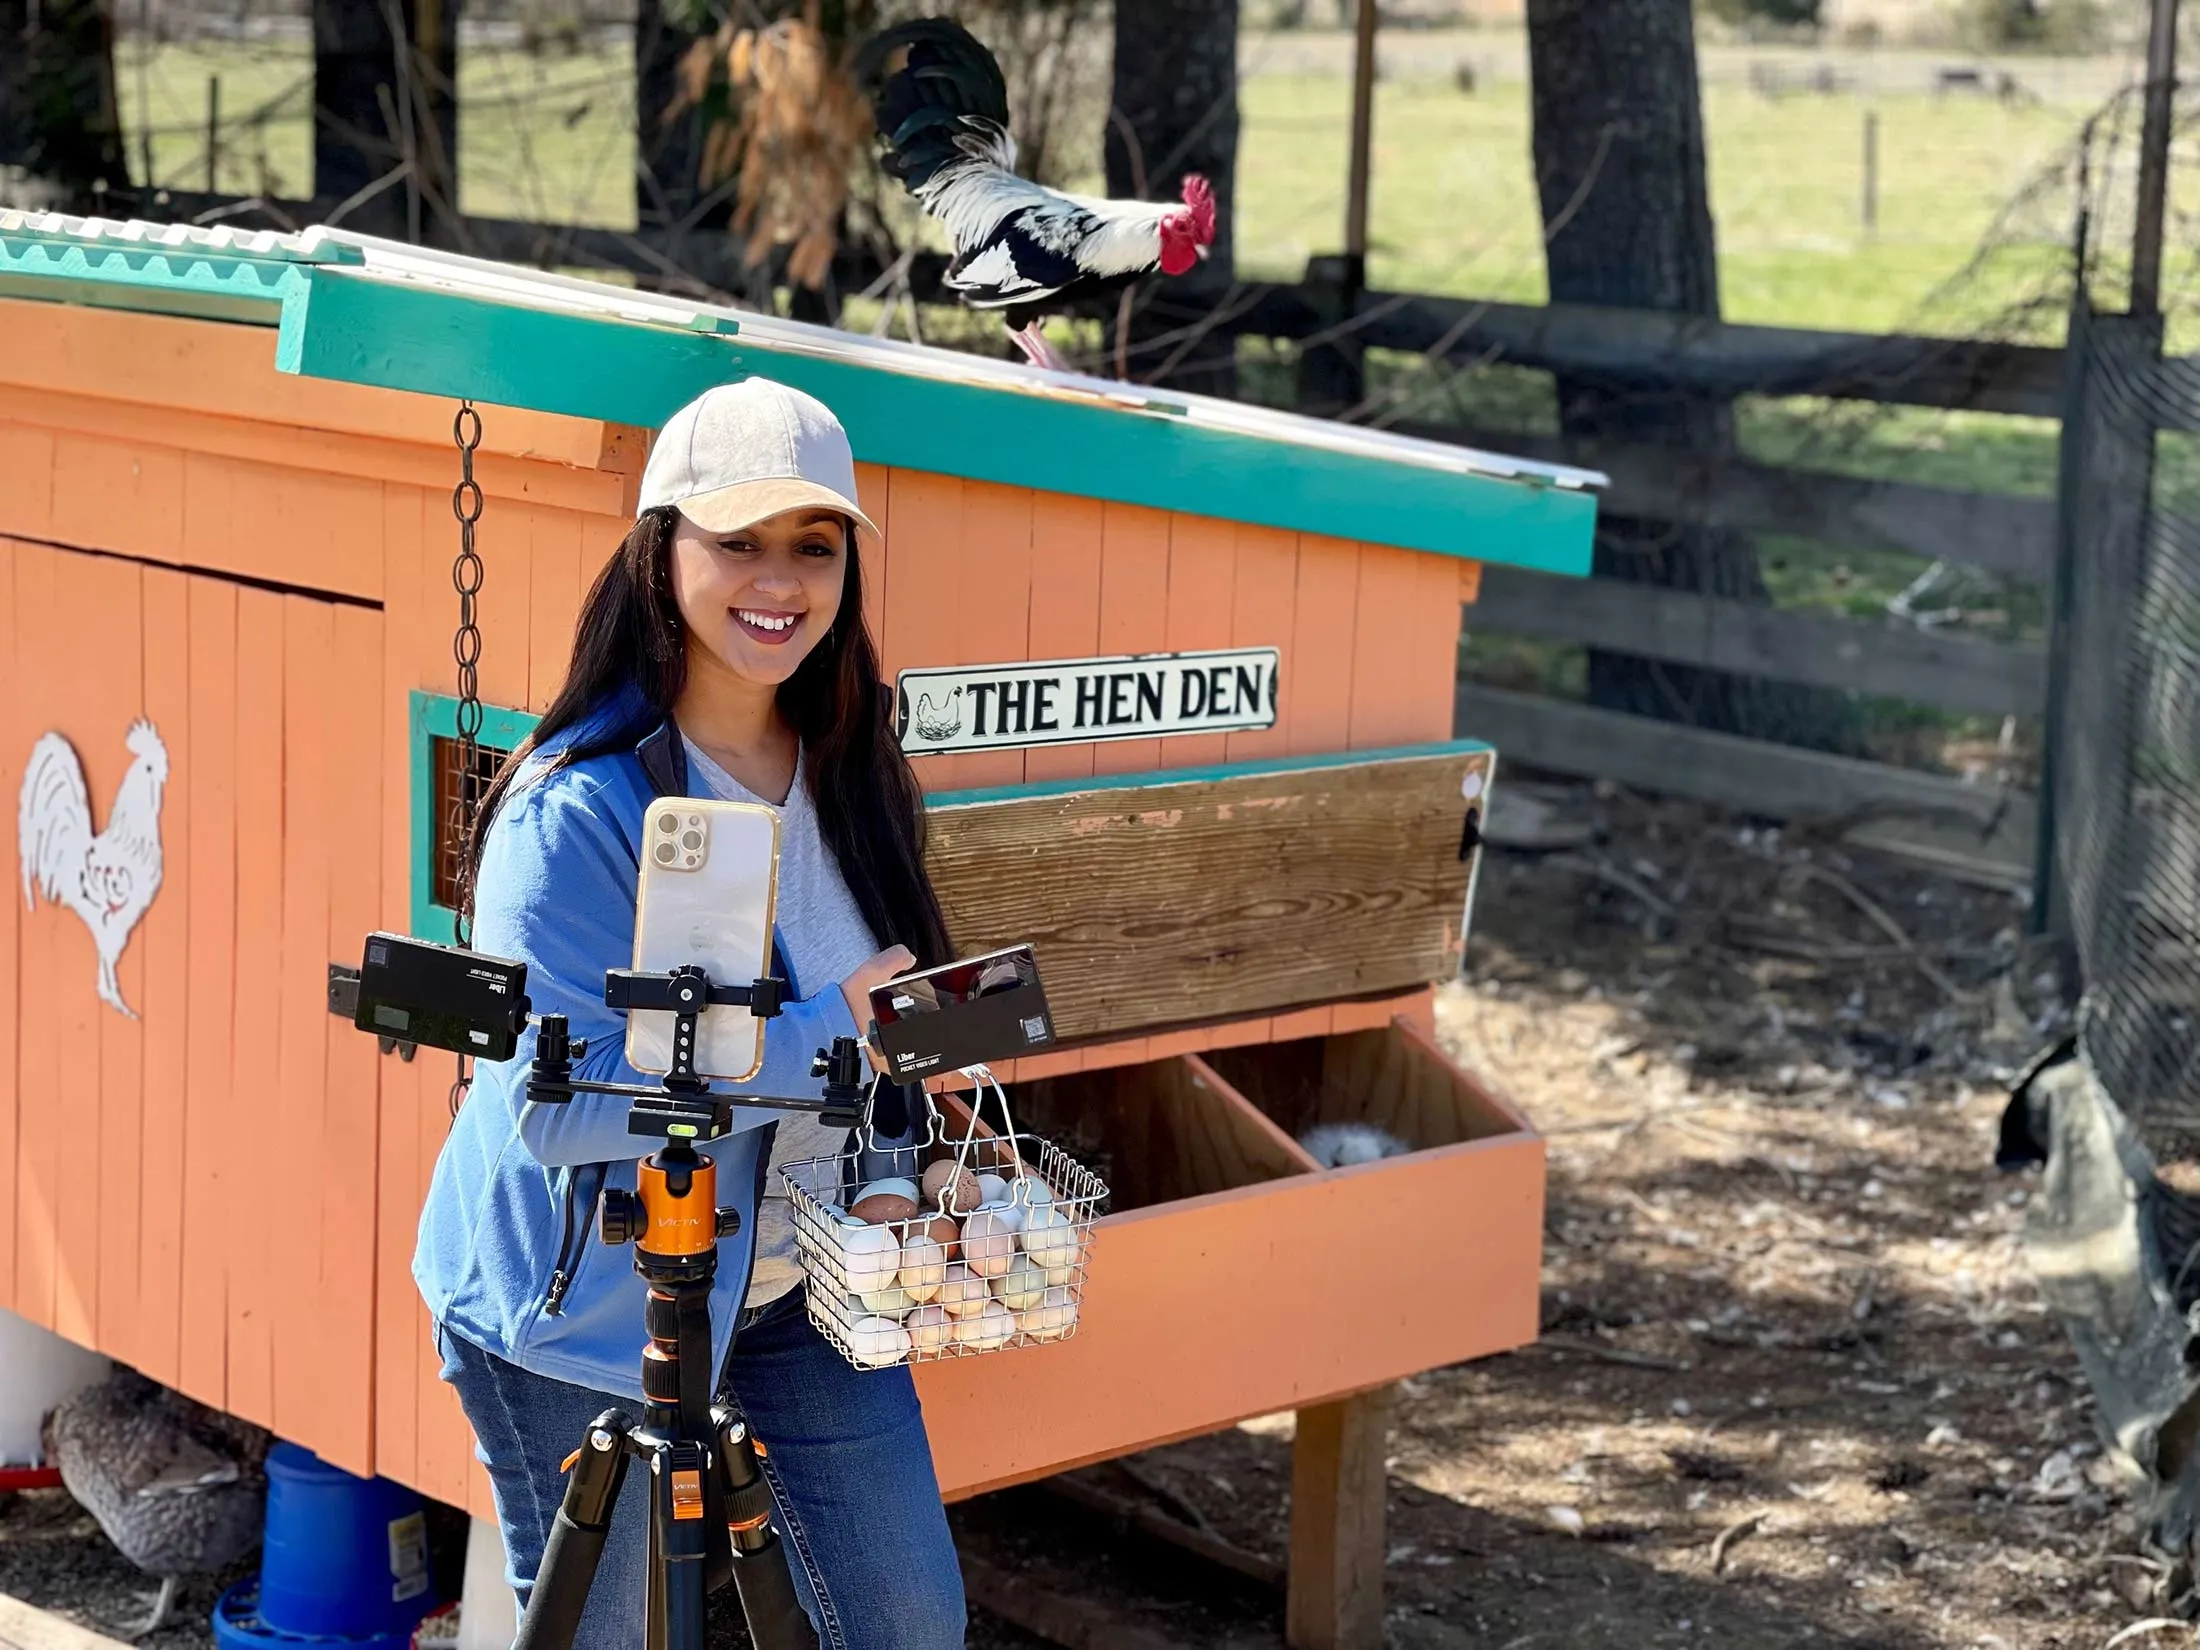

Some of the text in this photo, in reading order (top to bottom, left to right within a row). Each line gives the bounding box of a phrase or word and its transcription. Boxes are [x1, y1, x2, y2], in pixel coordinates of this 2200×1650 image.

[966, 664, 1263, 738] THE HEN DEN
